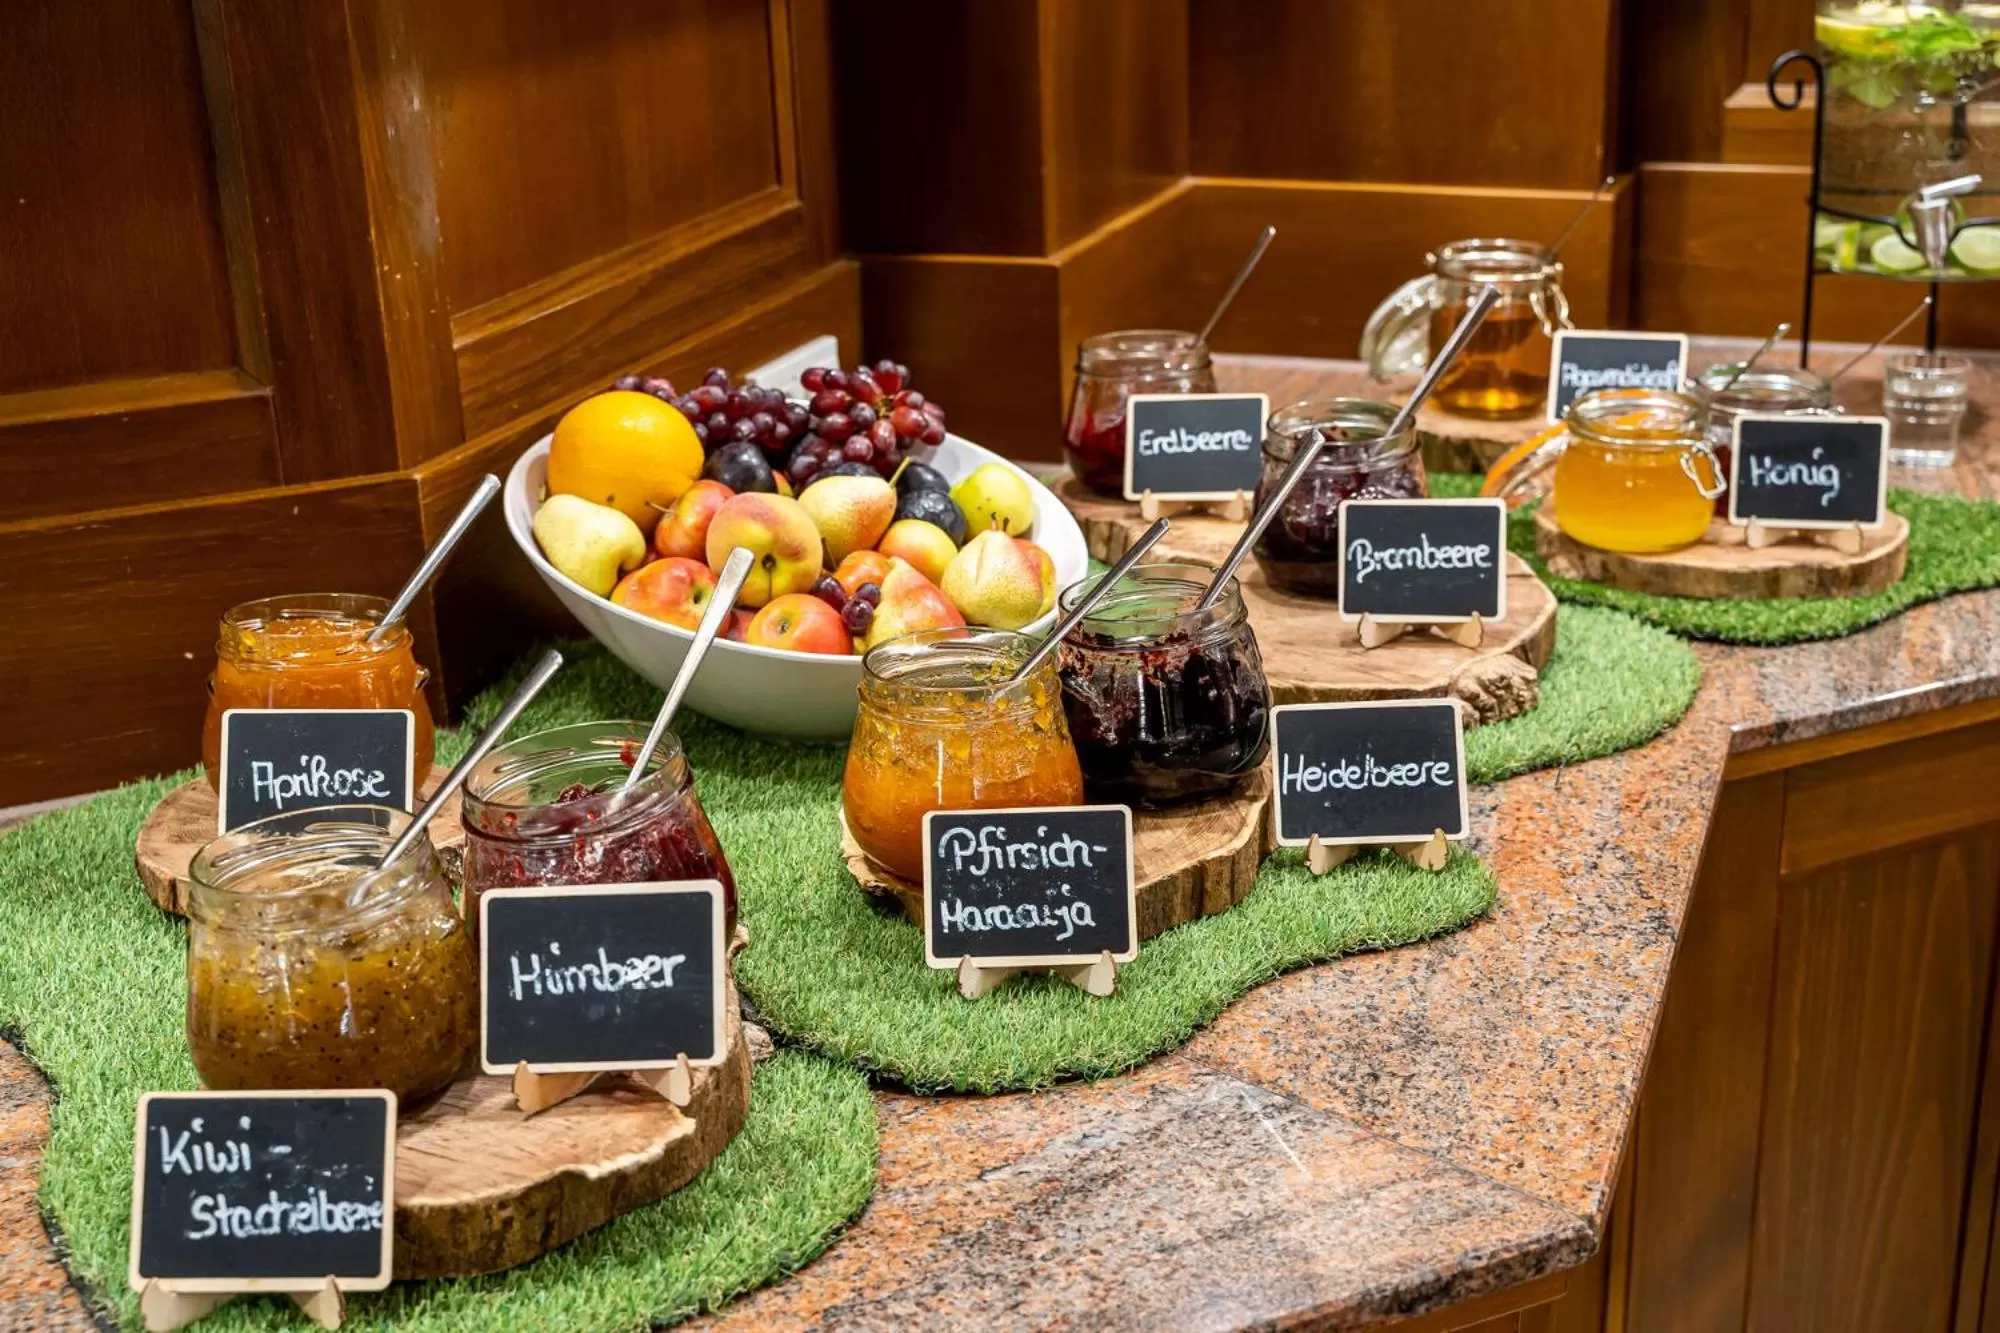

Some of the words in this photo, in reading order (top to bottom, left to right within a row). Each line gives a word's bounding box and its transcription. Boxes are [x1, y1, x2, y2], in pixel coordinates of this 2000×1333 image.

[1138, 426, 1252, 457] Erdbeere
[1749, 446, 1840, 507] Honig
[251, 754, 391, 810] Aprikose
[1282, 753, 1454, 795] Heidelbeere
[938, 825, 1107, 876] Pfirsich-
